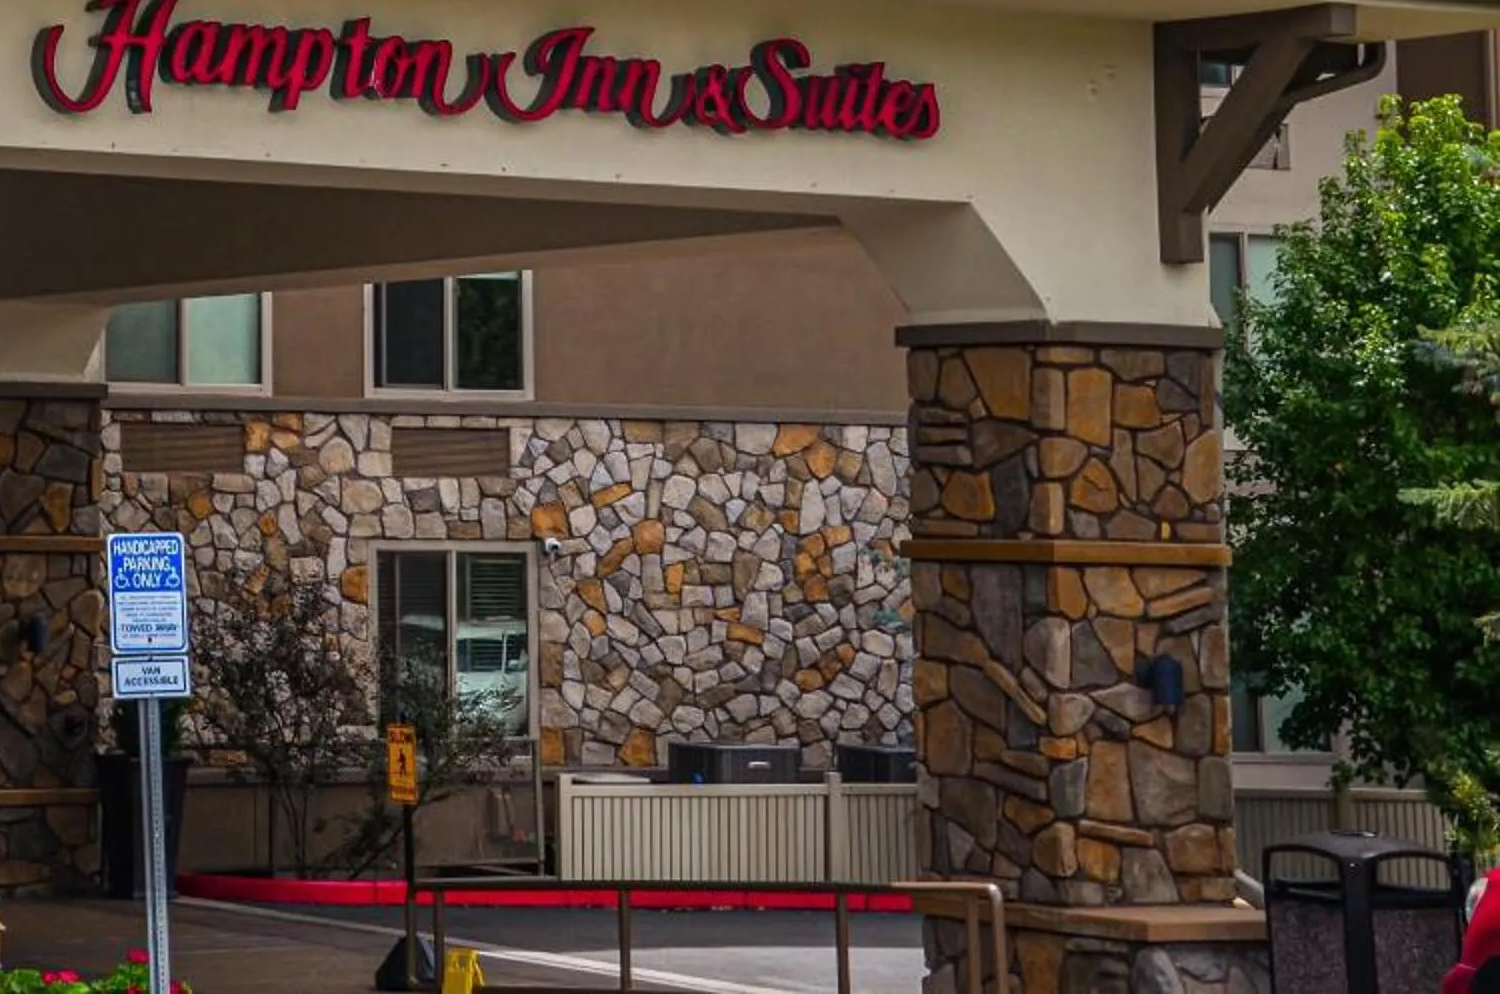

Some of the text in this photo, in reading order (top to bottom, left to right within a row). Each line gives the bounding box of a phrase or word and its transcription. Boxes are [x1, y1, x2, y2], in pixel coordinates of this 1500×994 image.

[484, 26, 697, 128] Inn
[736, 38, 941, 140] Suites
[113, 540, 179, 556] HANDICAPPED
[123, 555, 171, 572] PARKING
[132, 572, 162, 589] ONLY
[141, 666, 161, 675] VAN
[124, 675, 179, 687] ACCESSIBLE
